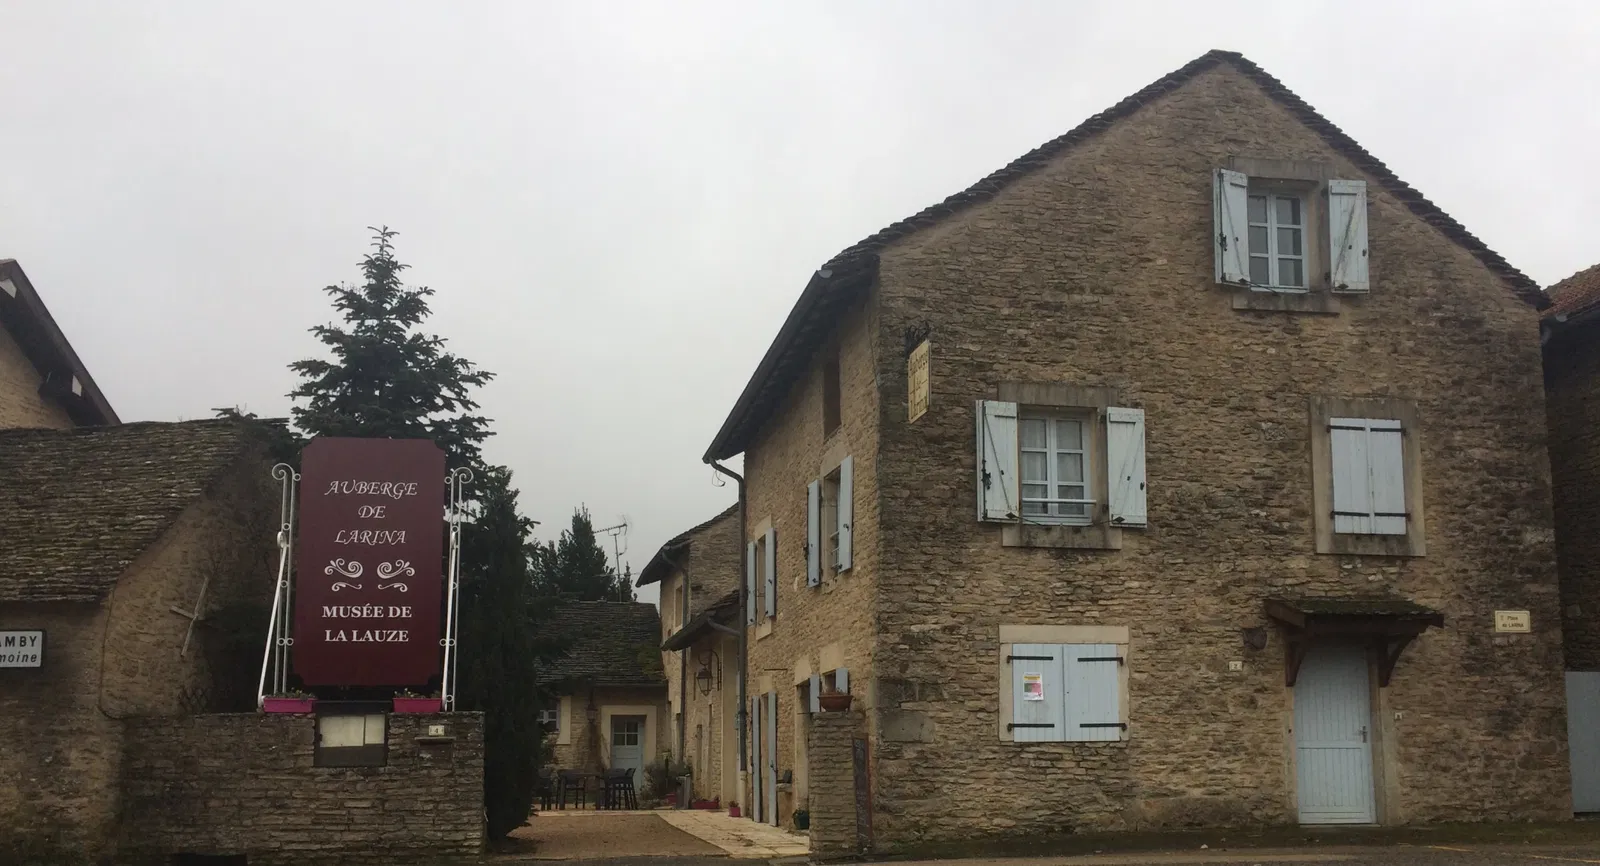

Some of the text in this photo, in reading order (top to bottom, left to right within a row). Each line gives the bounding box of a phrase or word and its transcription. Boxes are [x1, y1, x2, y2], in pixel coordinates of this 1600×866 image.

[323, 479, 418, 500] AUBERGE
[358, 505, 386, 519] DE
[334, 529, 406, 546] LARINA
[322, 602, 412, 618] MUSÉE DE
[324, 629, 409, 643] LA LAUZE
